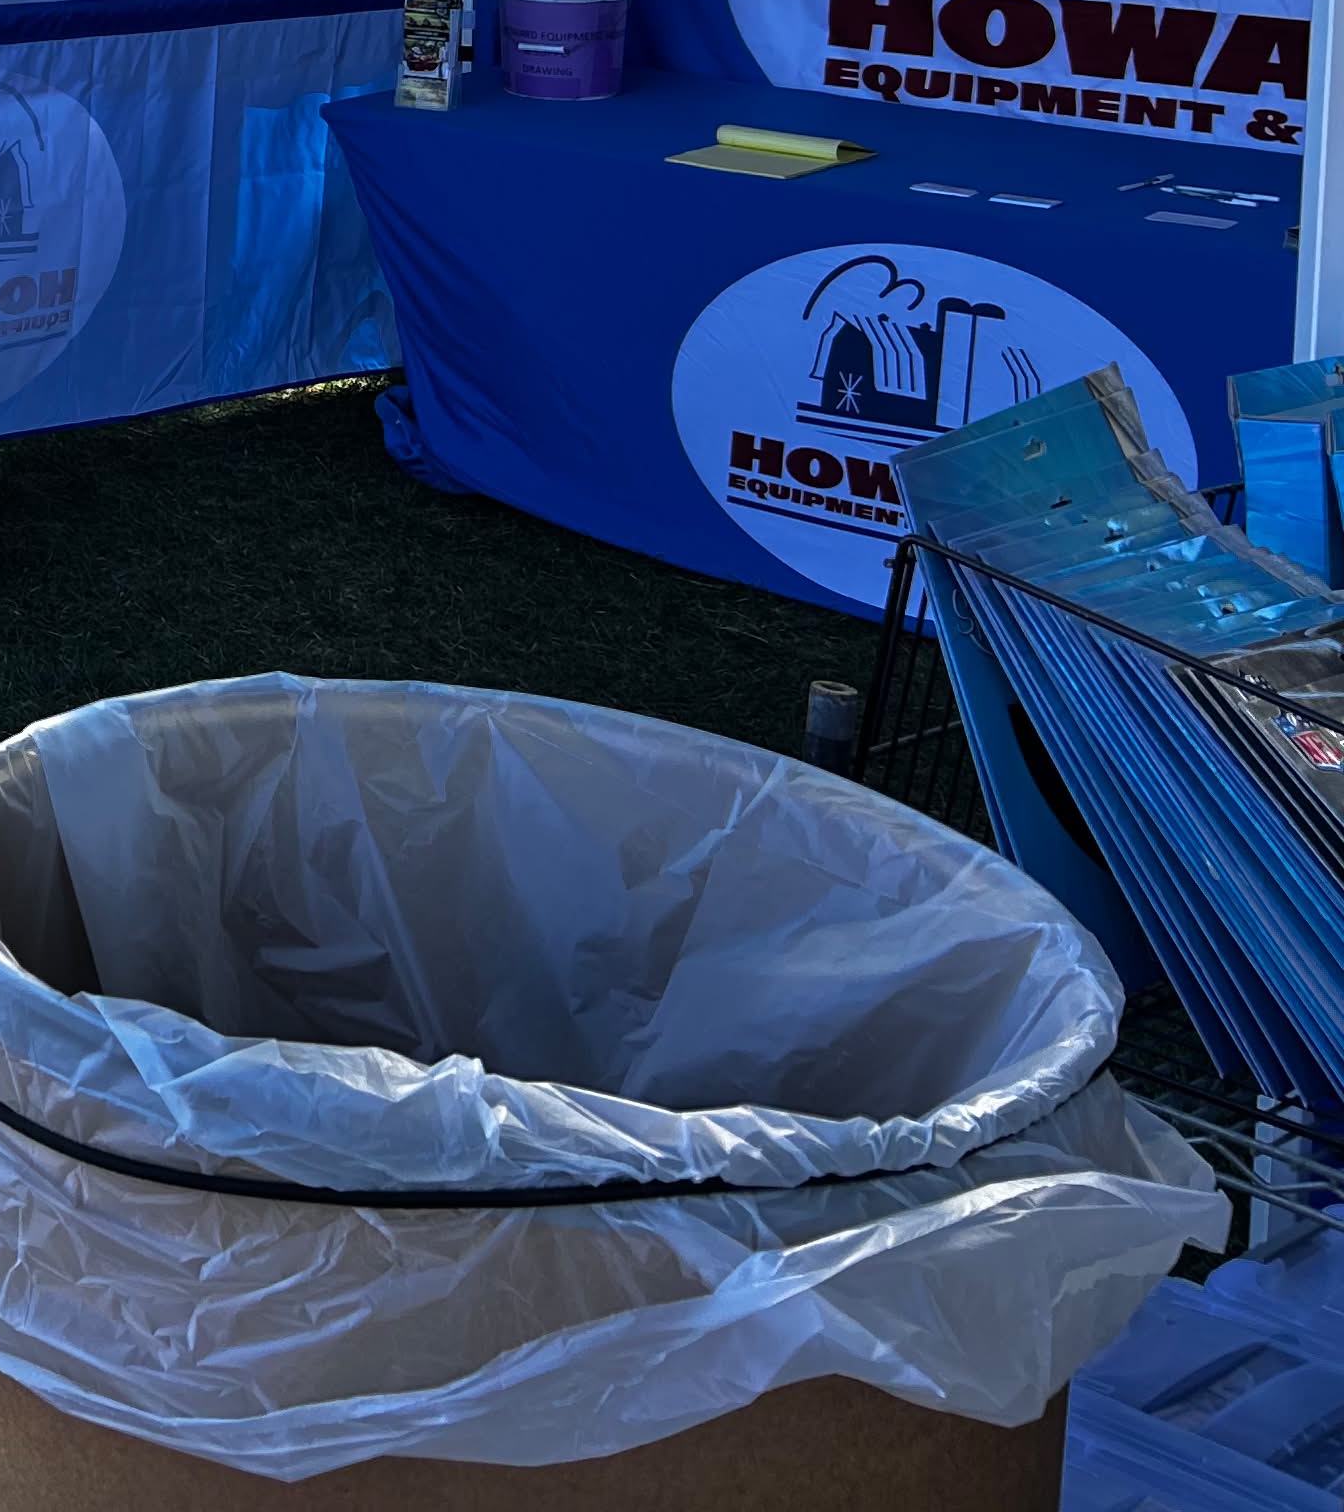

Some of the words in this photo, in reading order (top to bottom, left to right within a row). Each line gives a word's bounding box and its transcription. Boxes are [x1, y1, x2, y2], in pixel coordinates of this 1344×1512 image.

[824, 58, 1225, 134] EQUIPMENT
[1246, 108, 1302, 145] &
[729, 430, 902, 505] HOW
